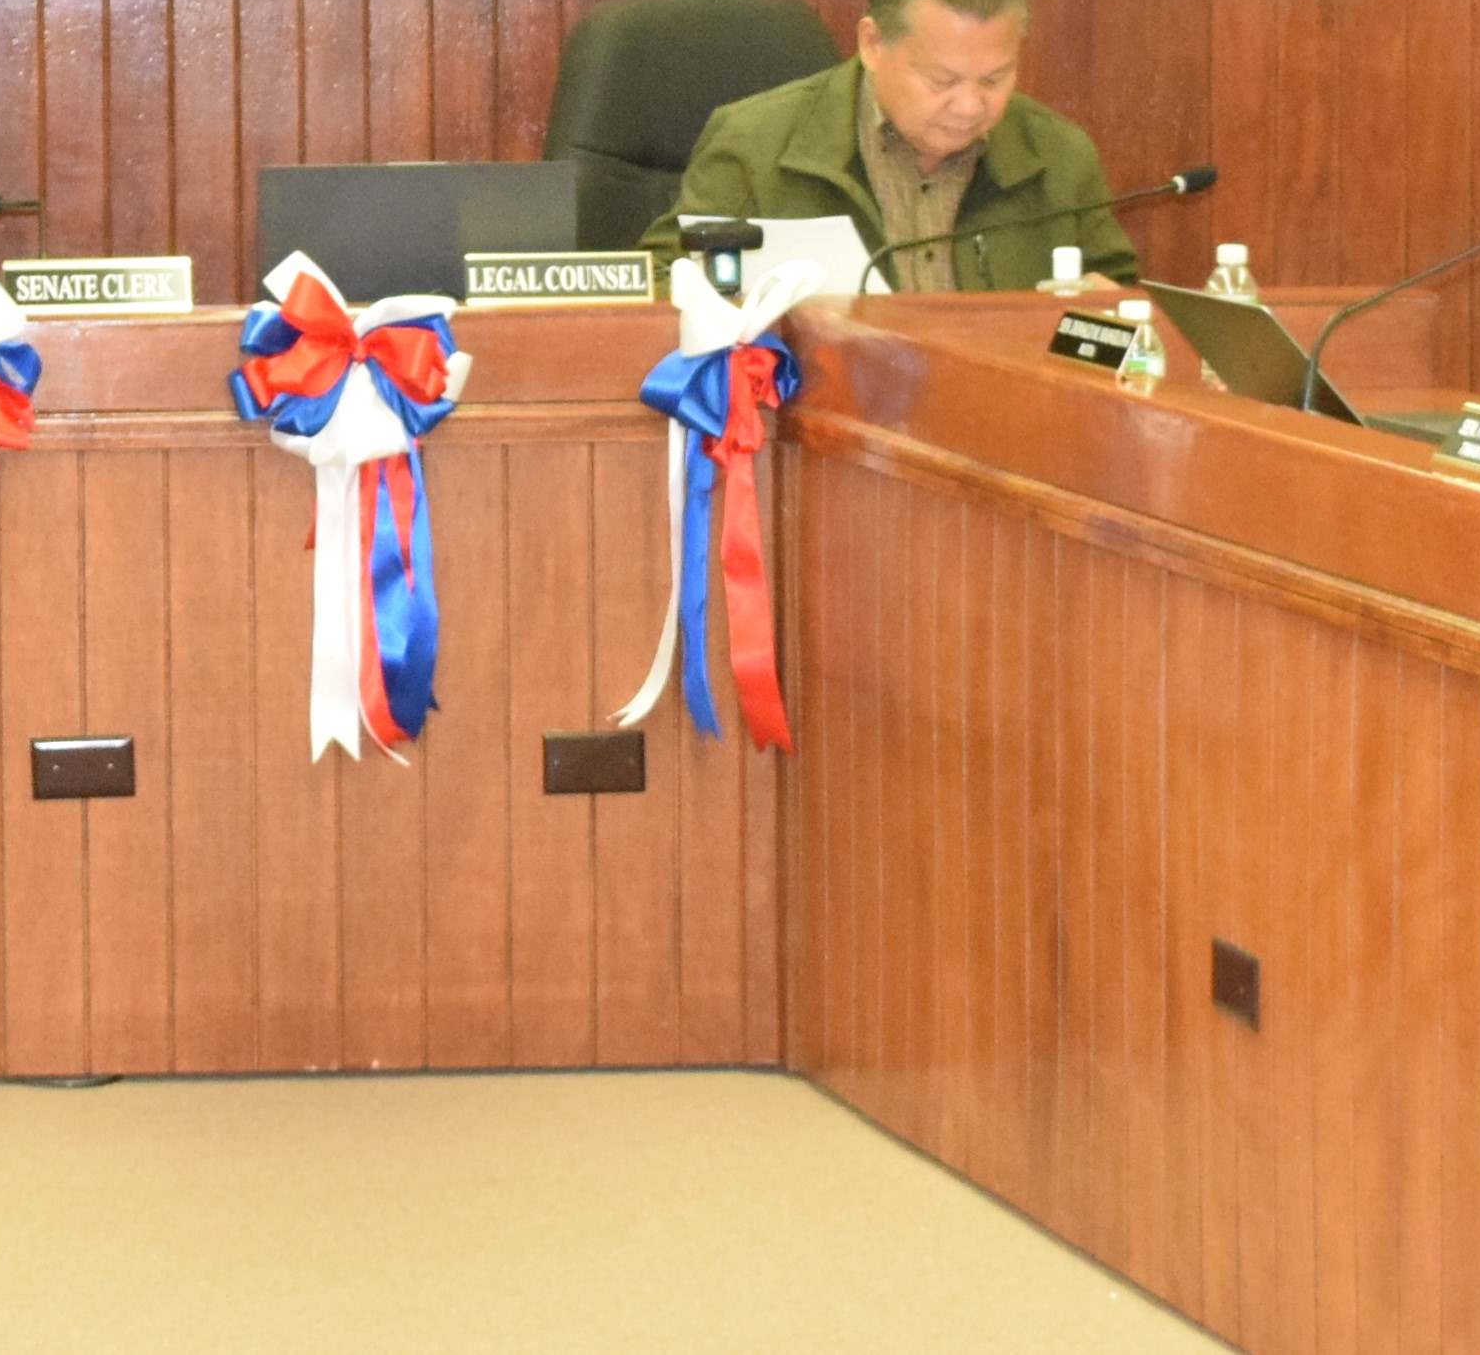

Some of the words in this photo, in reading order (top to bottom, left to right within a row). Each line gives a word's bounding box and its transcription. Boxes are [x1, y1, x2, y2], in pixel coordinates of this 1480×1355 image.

[16, 274, 98, 301] SENATE
[101, 272, 175, 299] CLERK
[467, 265, 542, 293] LEGAL
[544, 263, 647, 292] COUNSEL
